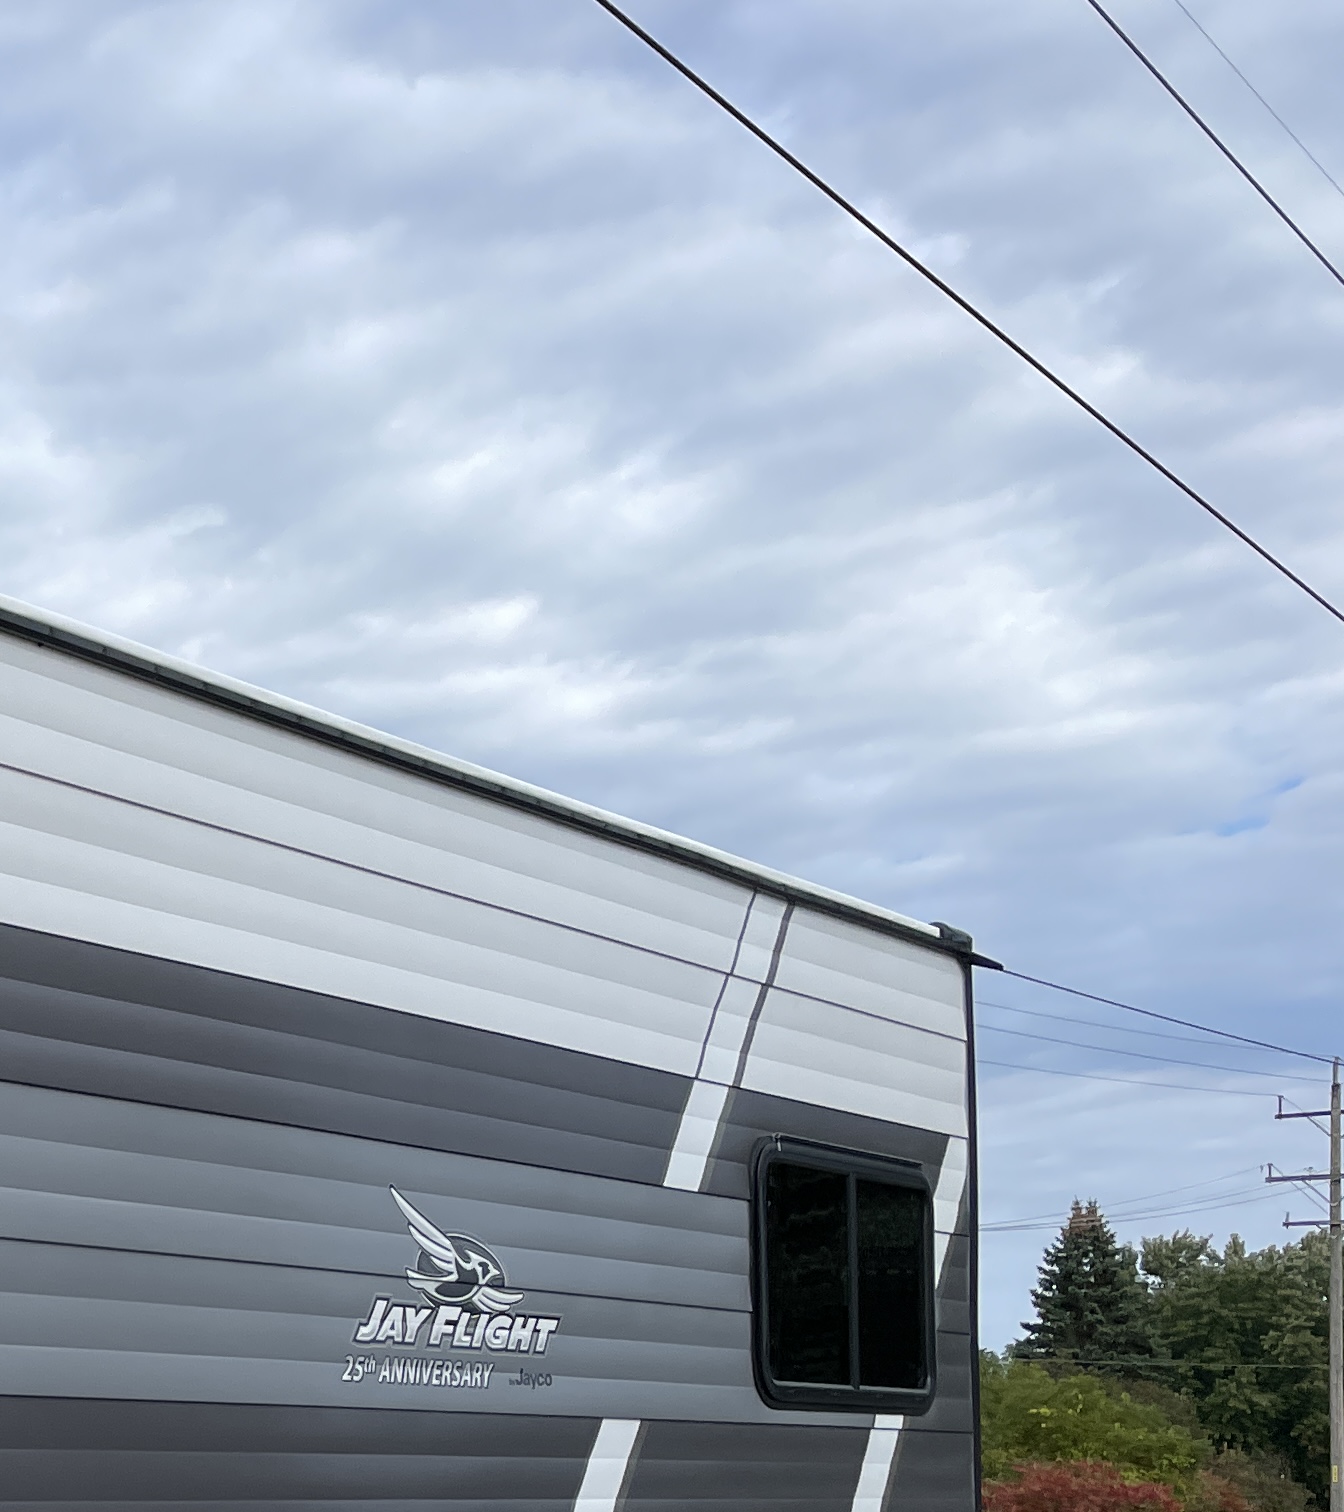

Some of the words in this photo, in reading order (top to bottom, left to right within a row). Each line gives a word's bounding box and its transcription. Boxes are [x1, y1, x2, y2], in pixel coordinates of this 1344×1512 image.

[355, 1299, 433, 1344] JAY
[427, 1305, 560, 1354] FLIGHT
[342, 1355, 377, 1383] 25th
[379, 1357, 495, 1388] ANNIVERSARY
[515, 1368, 553, 1390] Jayco
